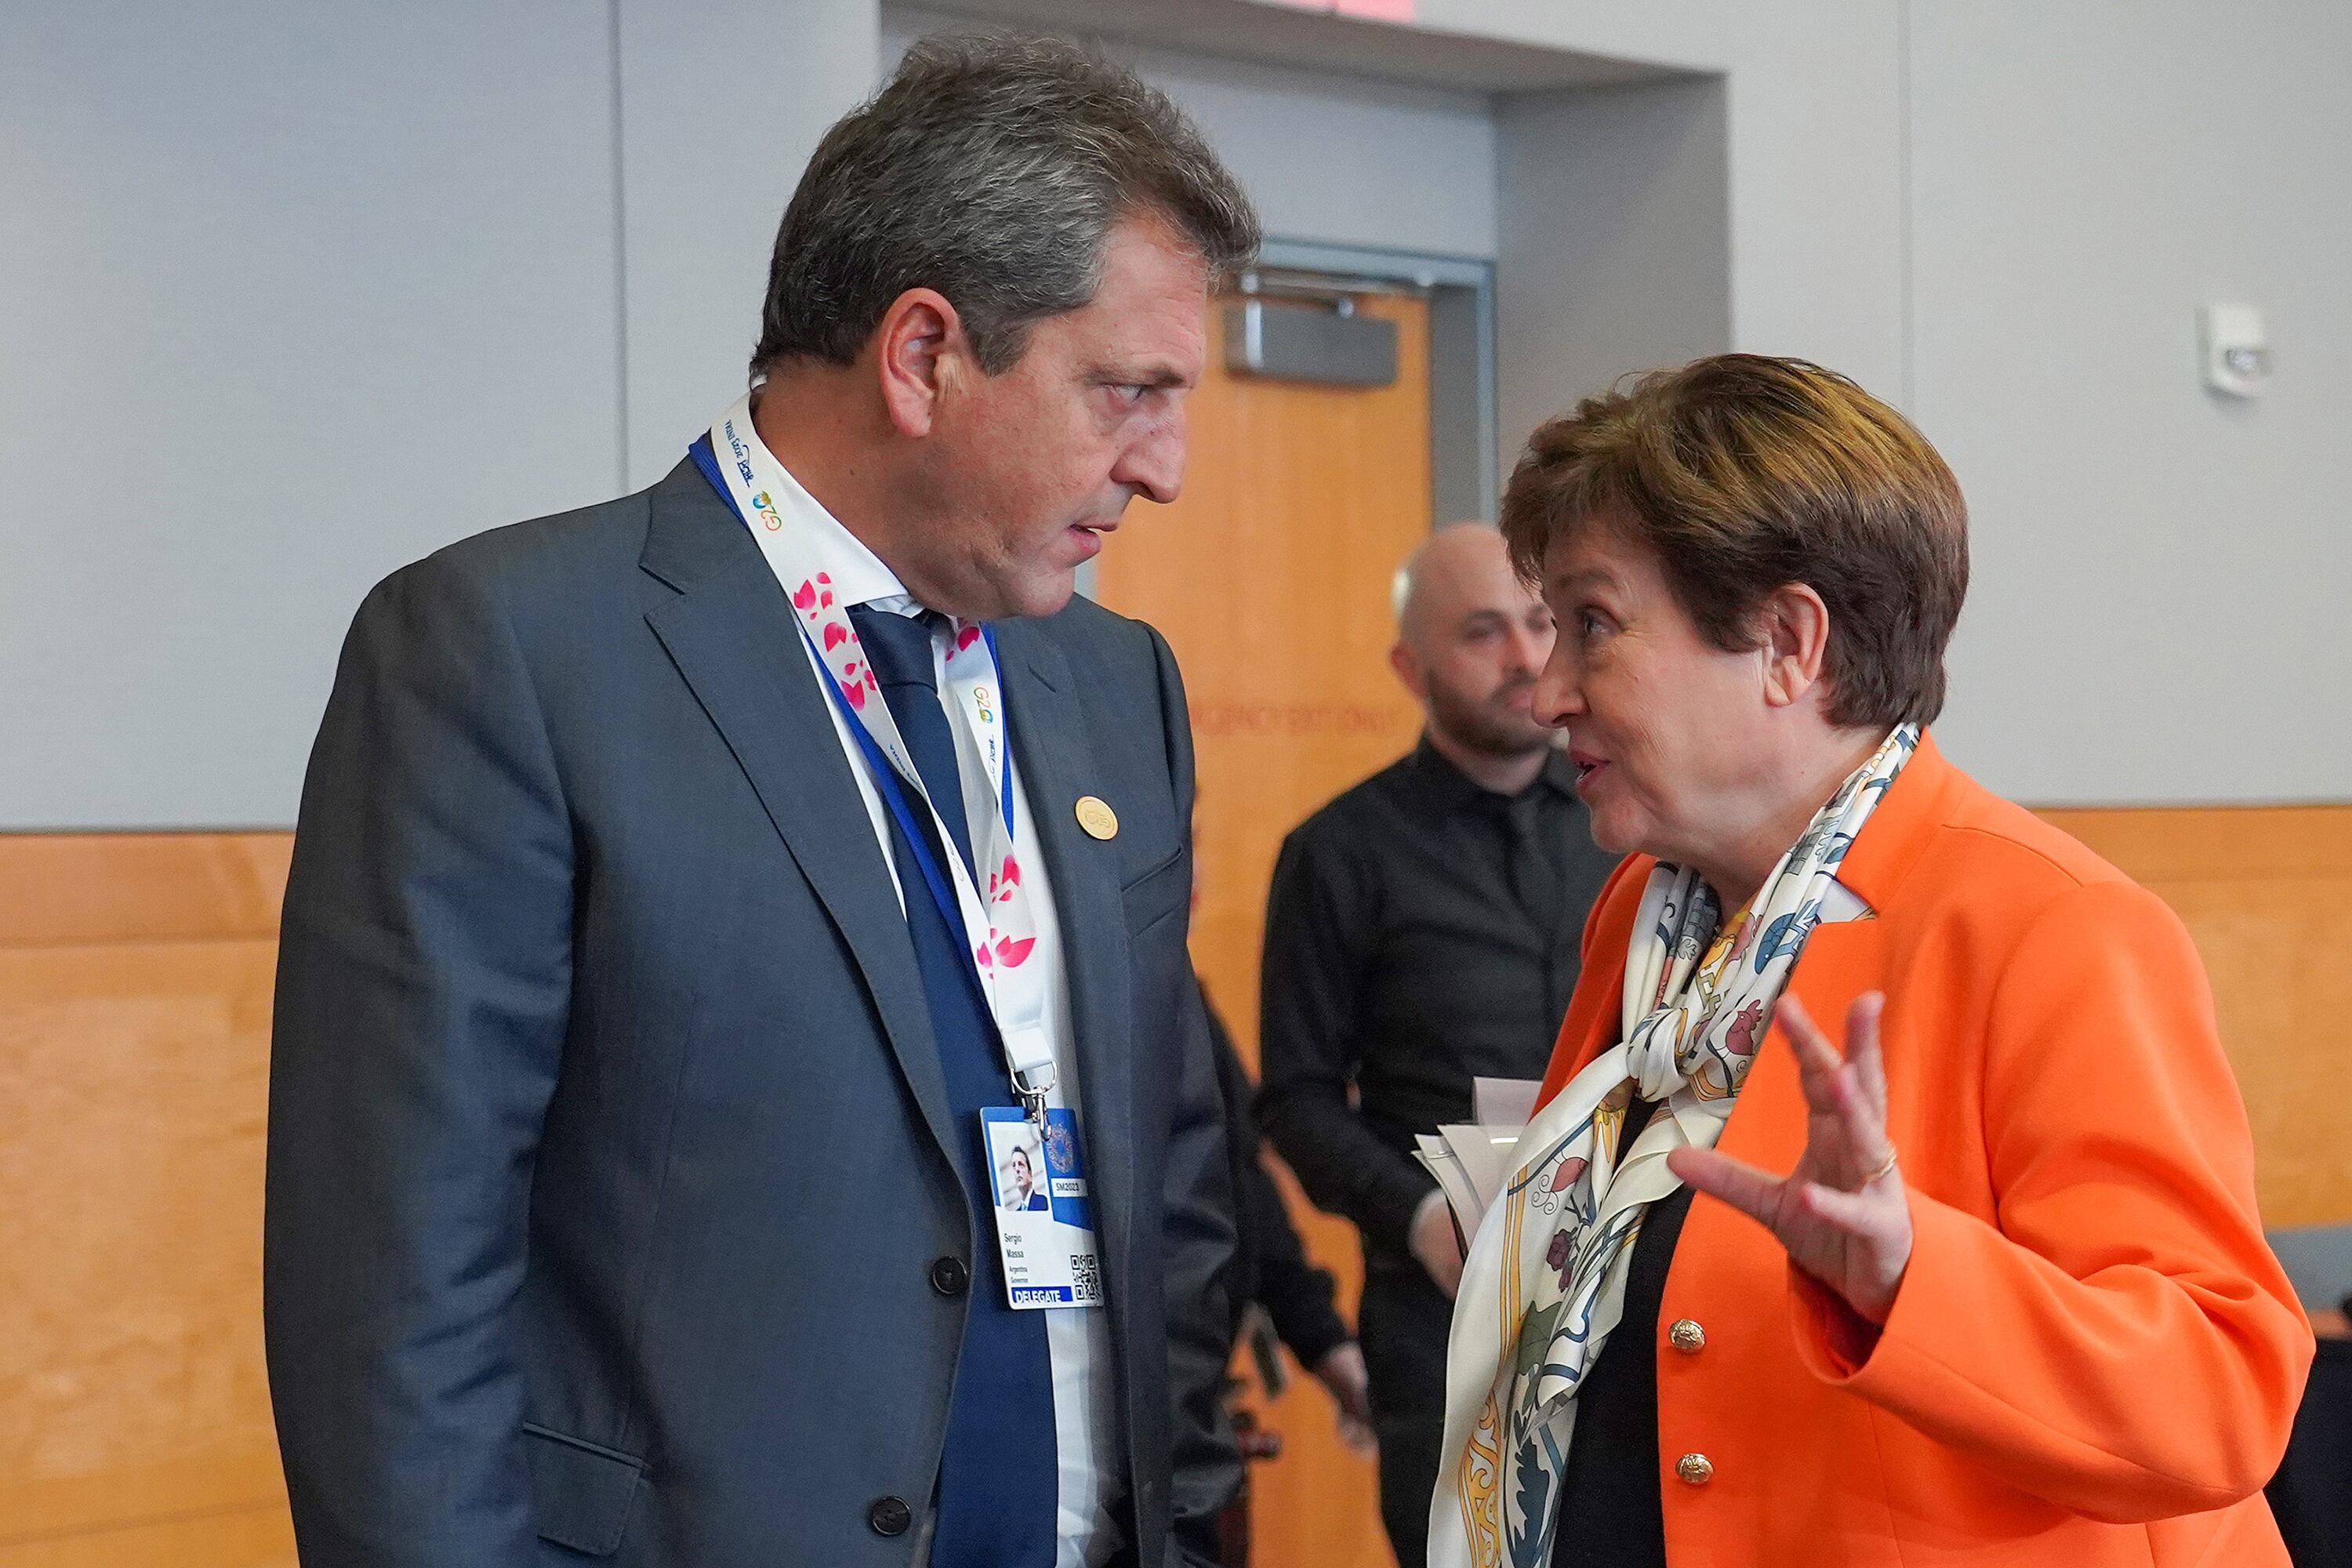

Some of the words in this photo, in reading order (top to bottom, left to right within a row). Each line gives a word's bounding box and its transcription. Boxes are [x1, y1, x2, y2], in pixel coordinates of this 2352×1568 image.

[724, 419, 737, 441] INDIA
[731, 437, 743, 459] 2023
[753, 491, 782, 532] G20
[974, 687, 994, 724] G20
[1056, 1182, 1080, 1192] SM2023
[1004, 1232, 1022, 1245] Sergio
[1006, 1248, 1024, 1258] Massa
[1014, 1290, 1062, 1303] DELEGATE
